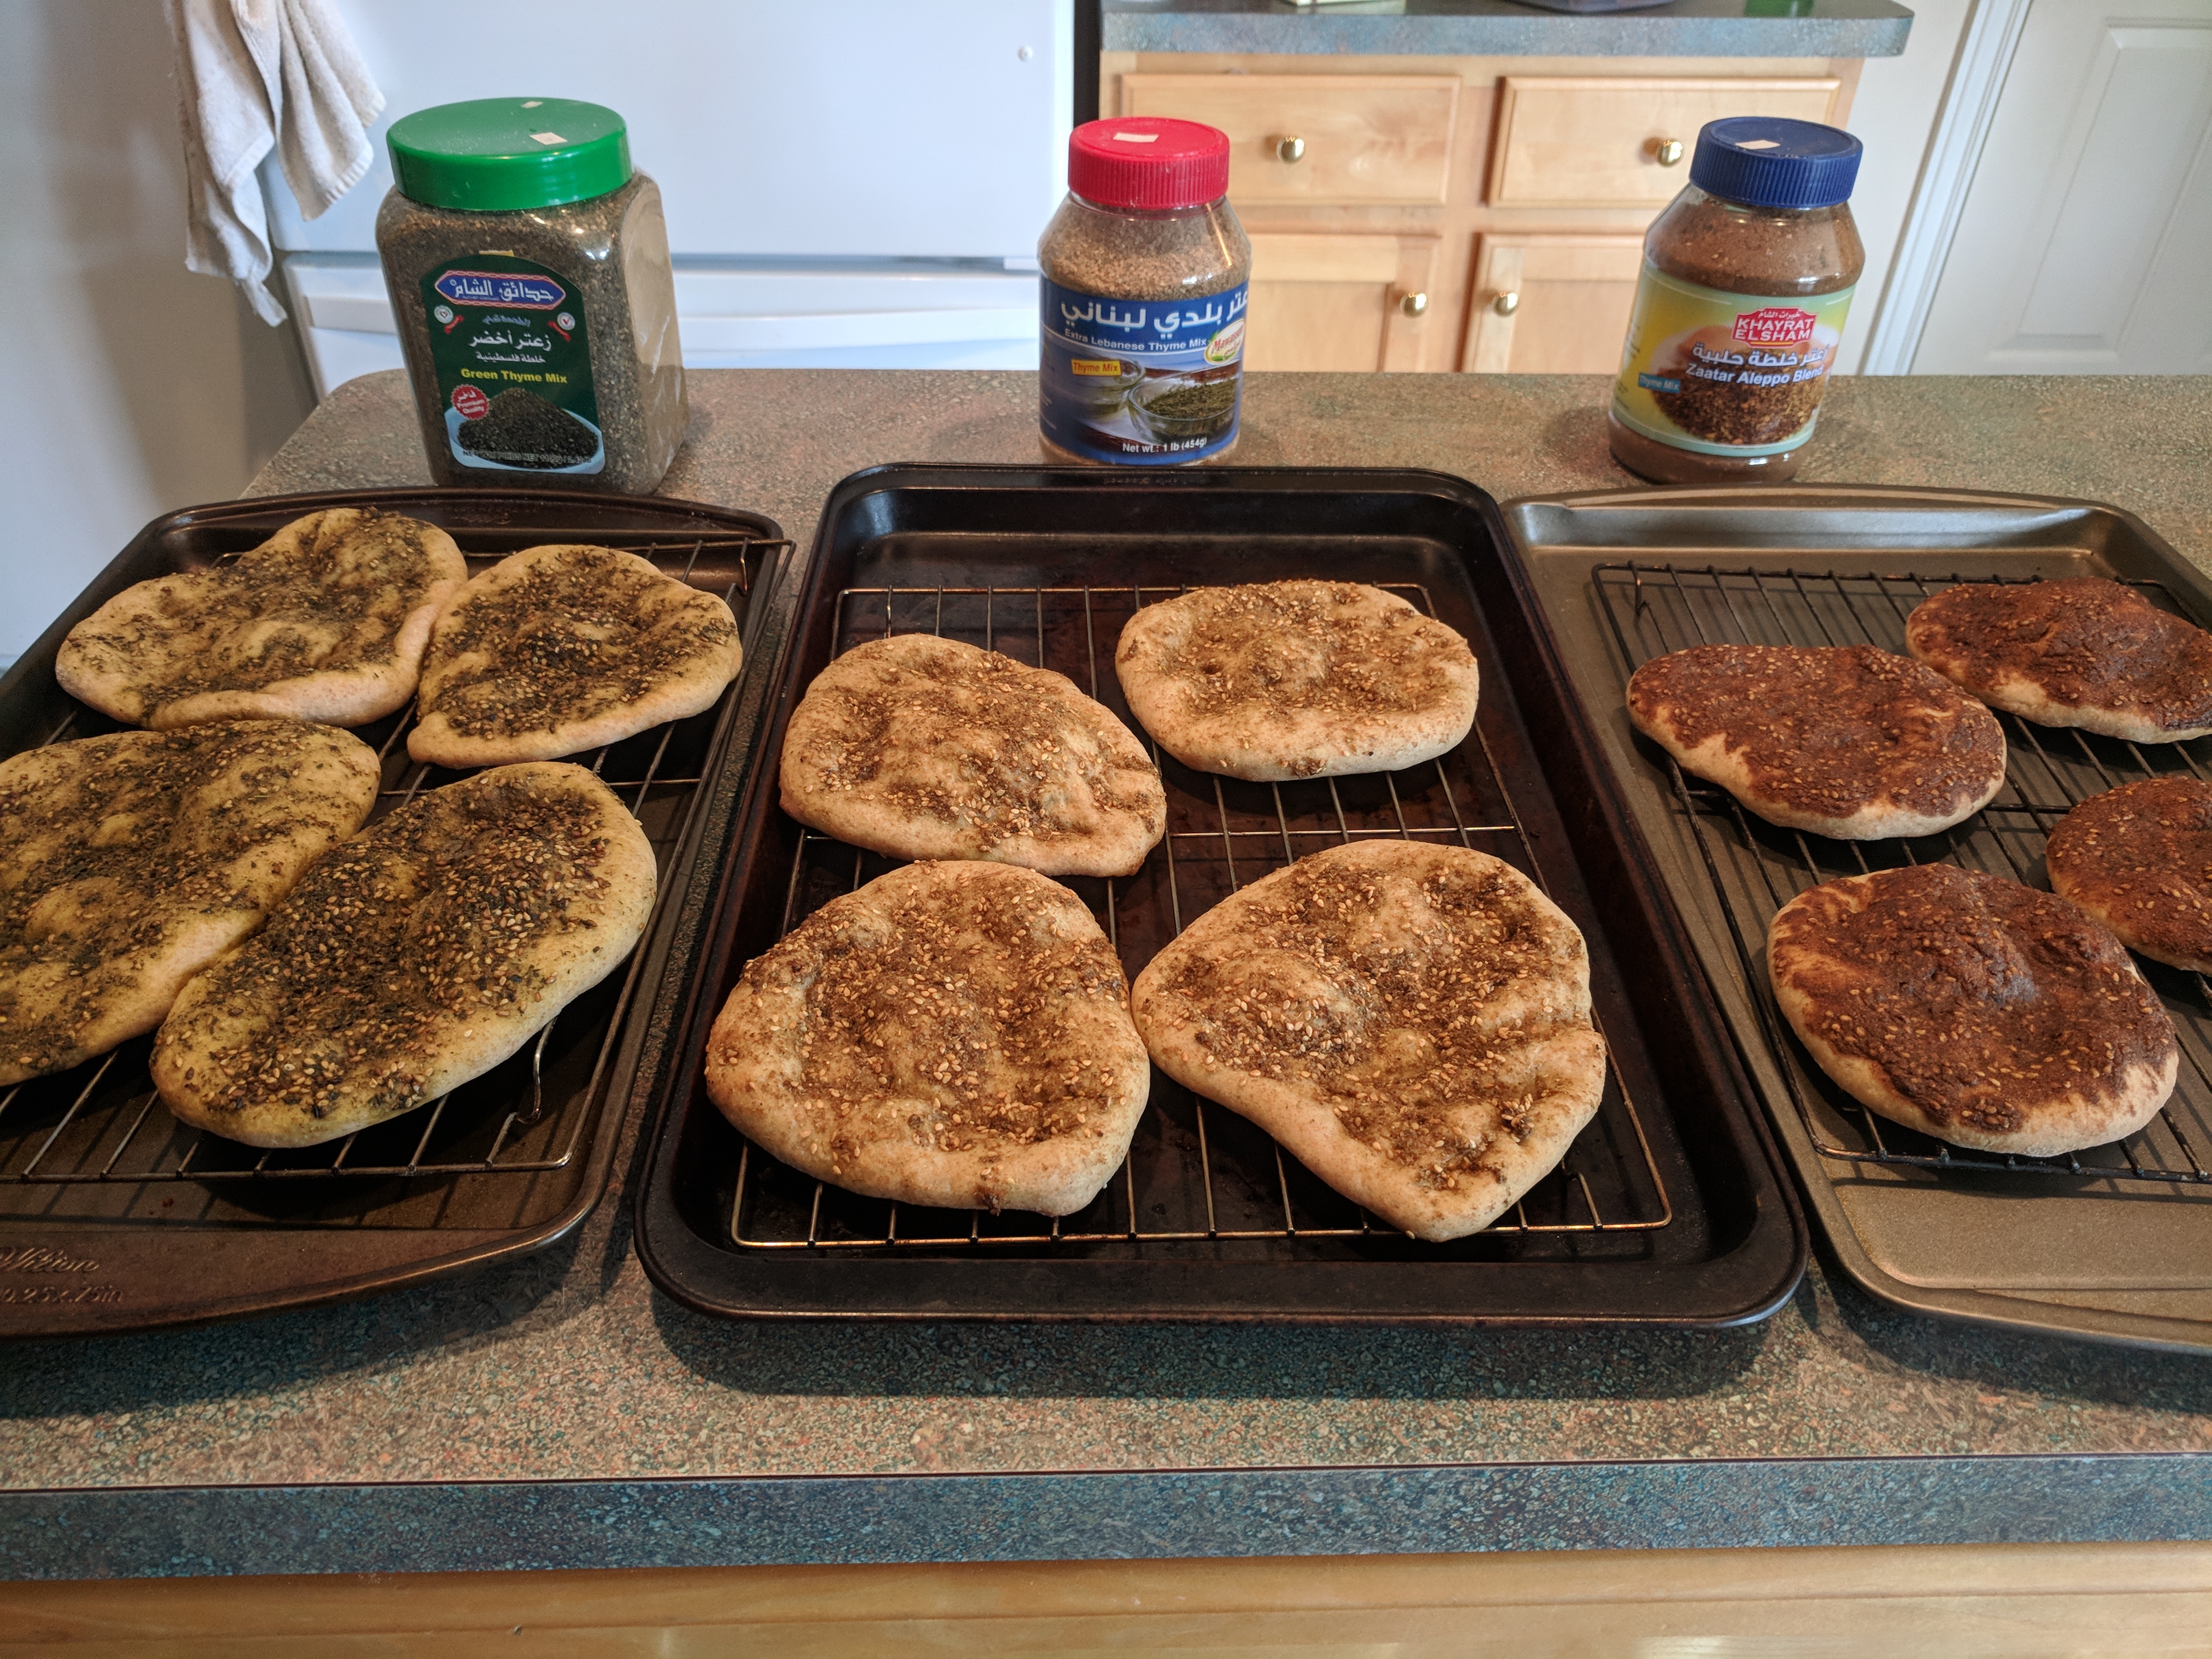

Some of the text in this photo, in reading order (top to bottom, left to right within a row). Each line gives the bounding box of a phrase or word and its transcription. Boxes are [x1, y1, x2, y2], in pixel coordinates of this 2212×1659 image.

[455, 278, 554, 302] حدائق الشام
[1061, 291, 1248, 340] عتر بلدي لبناني
[1737, 318, 1814, 331] KHAYRAT
[469, 330, 552, 352] زعتر أخضر
[1065, 328, 1207, 352] Extra Lebanese Thyme Mix
[1734, 328, 1811, 341] ELSHAM
[1693, 343, 1745, 365] حلبية
[1748, 349, 1799, 367] خلطة
[461, 368, 568, 383] Green Thyme Mix
[1074, 362, 1118, 373] Thyme Mix
[1685, 362, 1824, 387] Zaatar Aleppo Blend
[1122, 443, 1139, 452] Net
[1170, 442, 1179, 451] lb
[1181, 437, 1207, 450] (454g)
